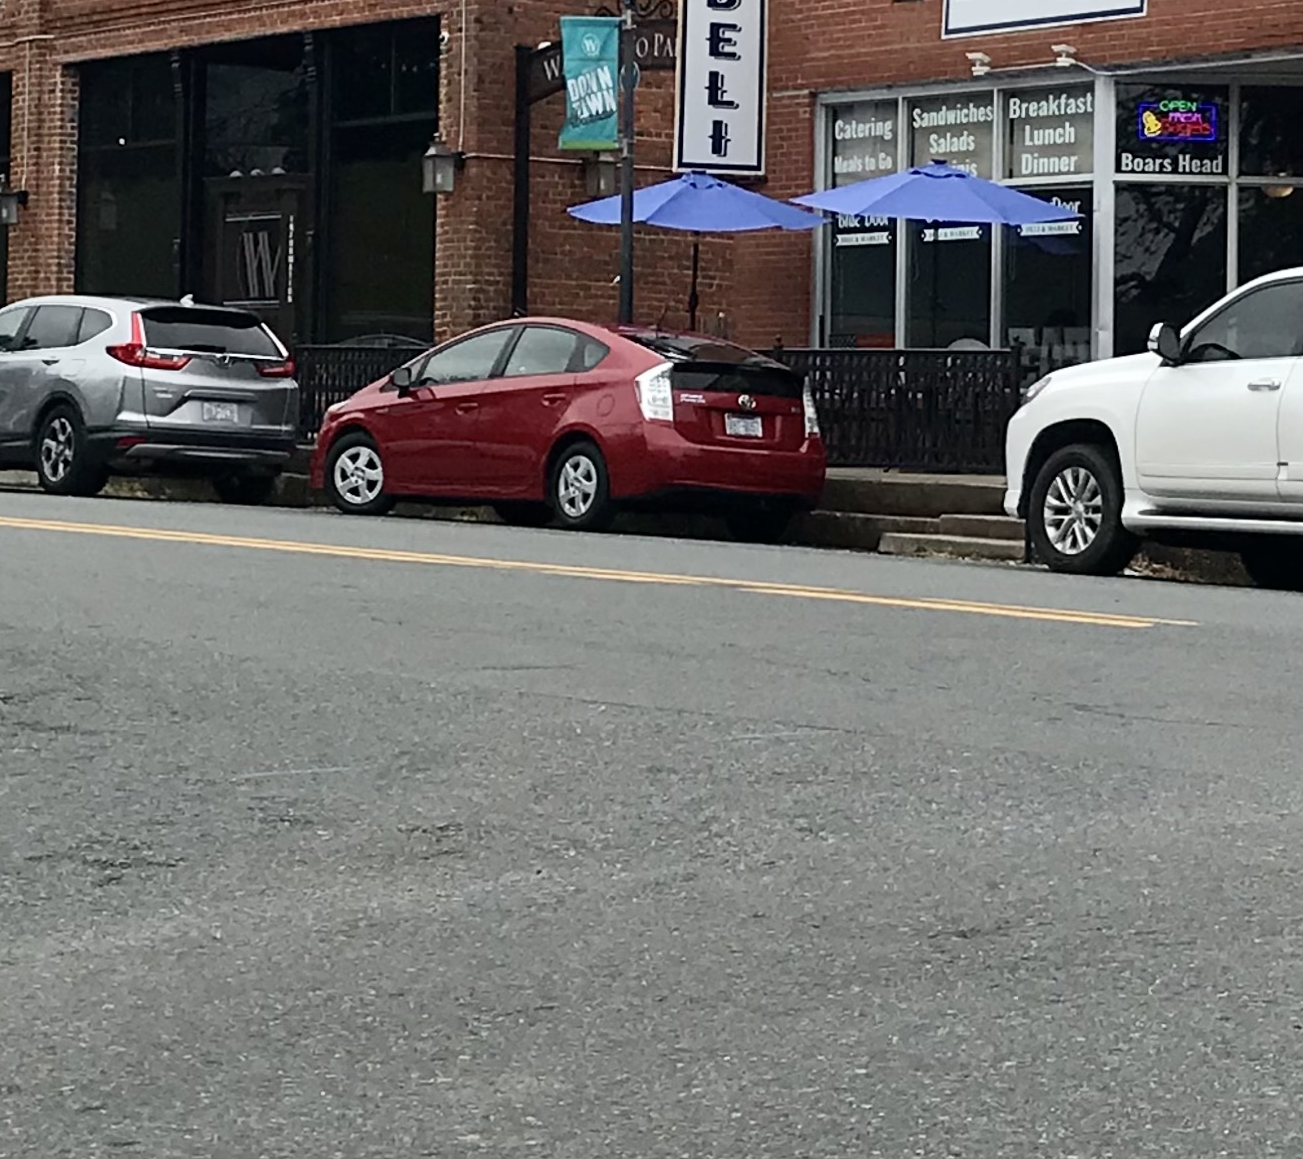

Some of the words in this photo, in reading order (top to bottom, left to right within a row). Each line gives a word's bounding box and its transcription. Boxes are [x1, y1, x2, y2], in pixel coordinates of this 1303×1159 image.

[567, 65, 613, 102] DOWN
[912, 103, 994, 129] Sandwiches
[1009, 92, 1093, 119] Breakfast
[1159, 100, 1197, 112] OPEN
[834, 117, 893, 140] Catering
[1024, 122, 1075, 146] Lunch
[929, 131, 976, 154] Salads
[834, 155, 863, 174] Meals
[864, 155, 877, 172] to
[878, 152, 893, 170] Go
[1021, 153, 1078, 175] Dinner
[1121, 152, 1172, 172] Boars
[1178, 154, 1223, 173] Head
